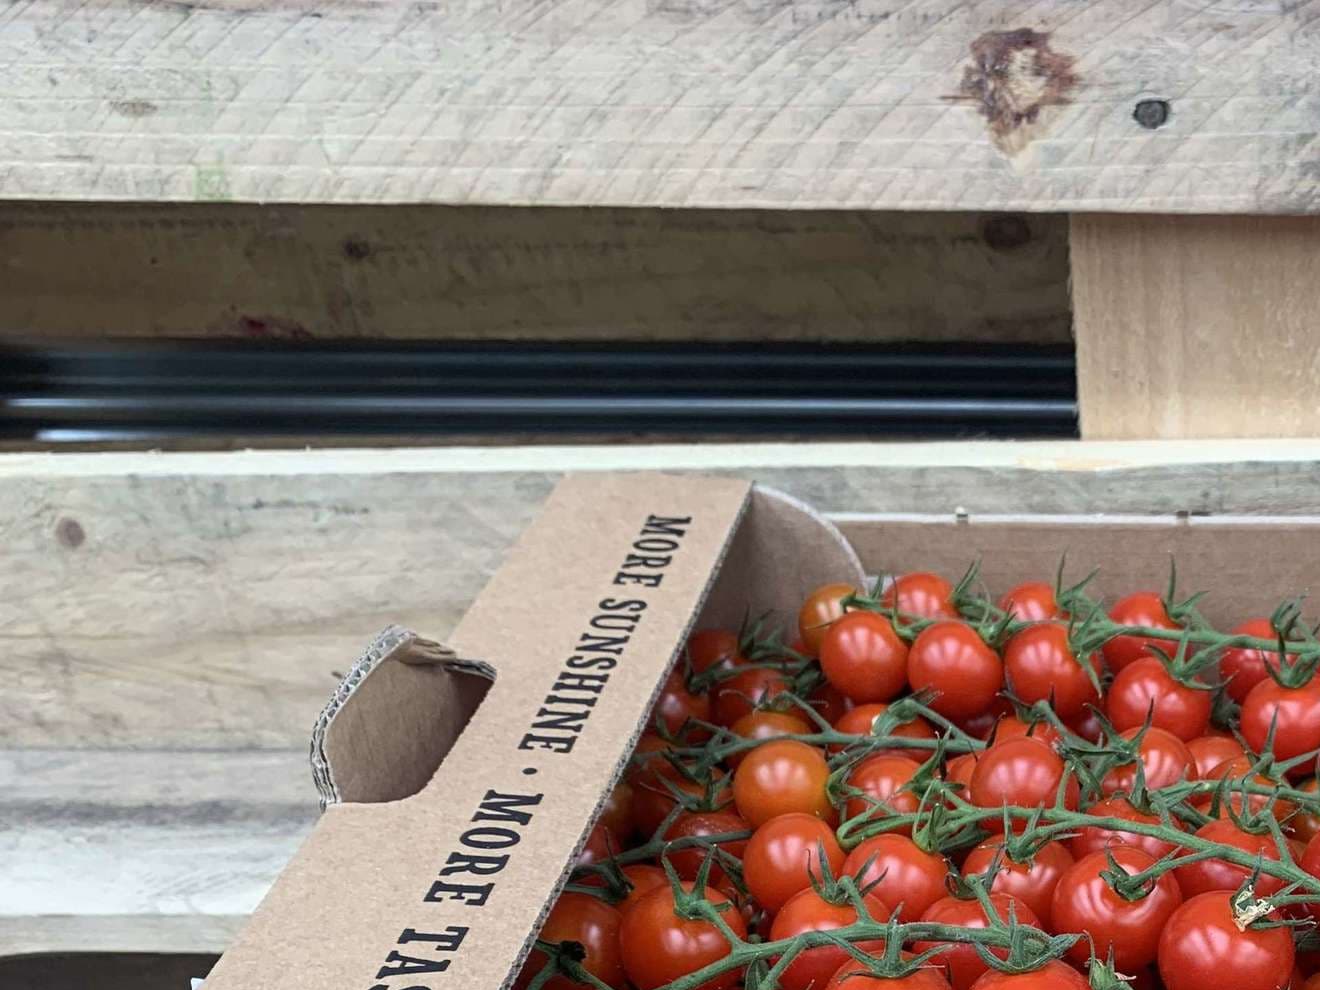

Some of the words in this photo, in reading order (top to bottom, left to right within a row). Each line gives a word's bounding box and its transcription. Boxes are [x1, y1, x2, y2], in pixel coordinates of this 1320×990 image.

[612, 514, 693, 588] MORE
[518, 598, 648, 755] SUNSHINE
[422, 789, 545, 908] MORE
